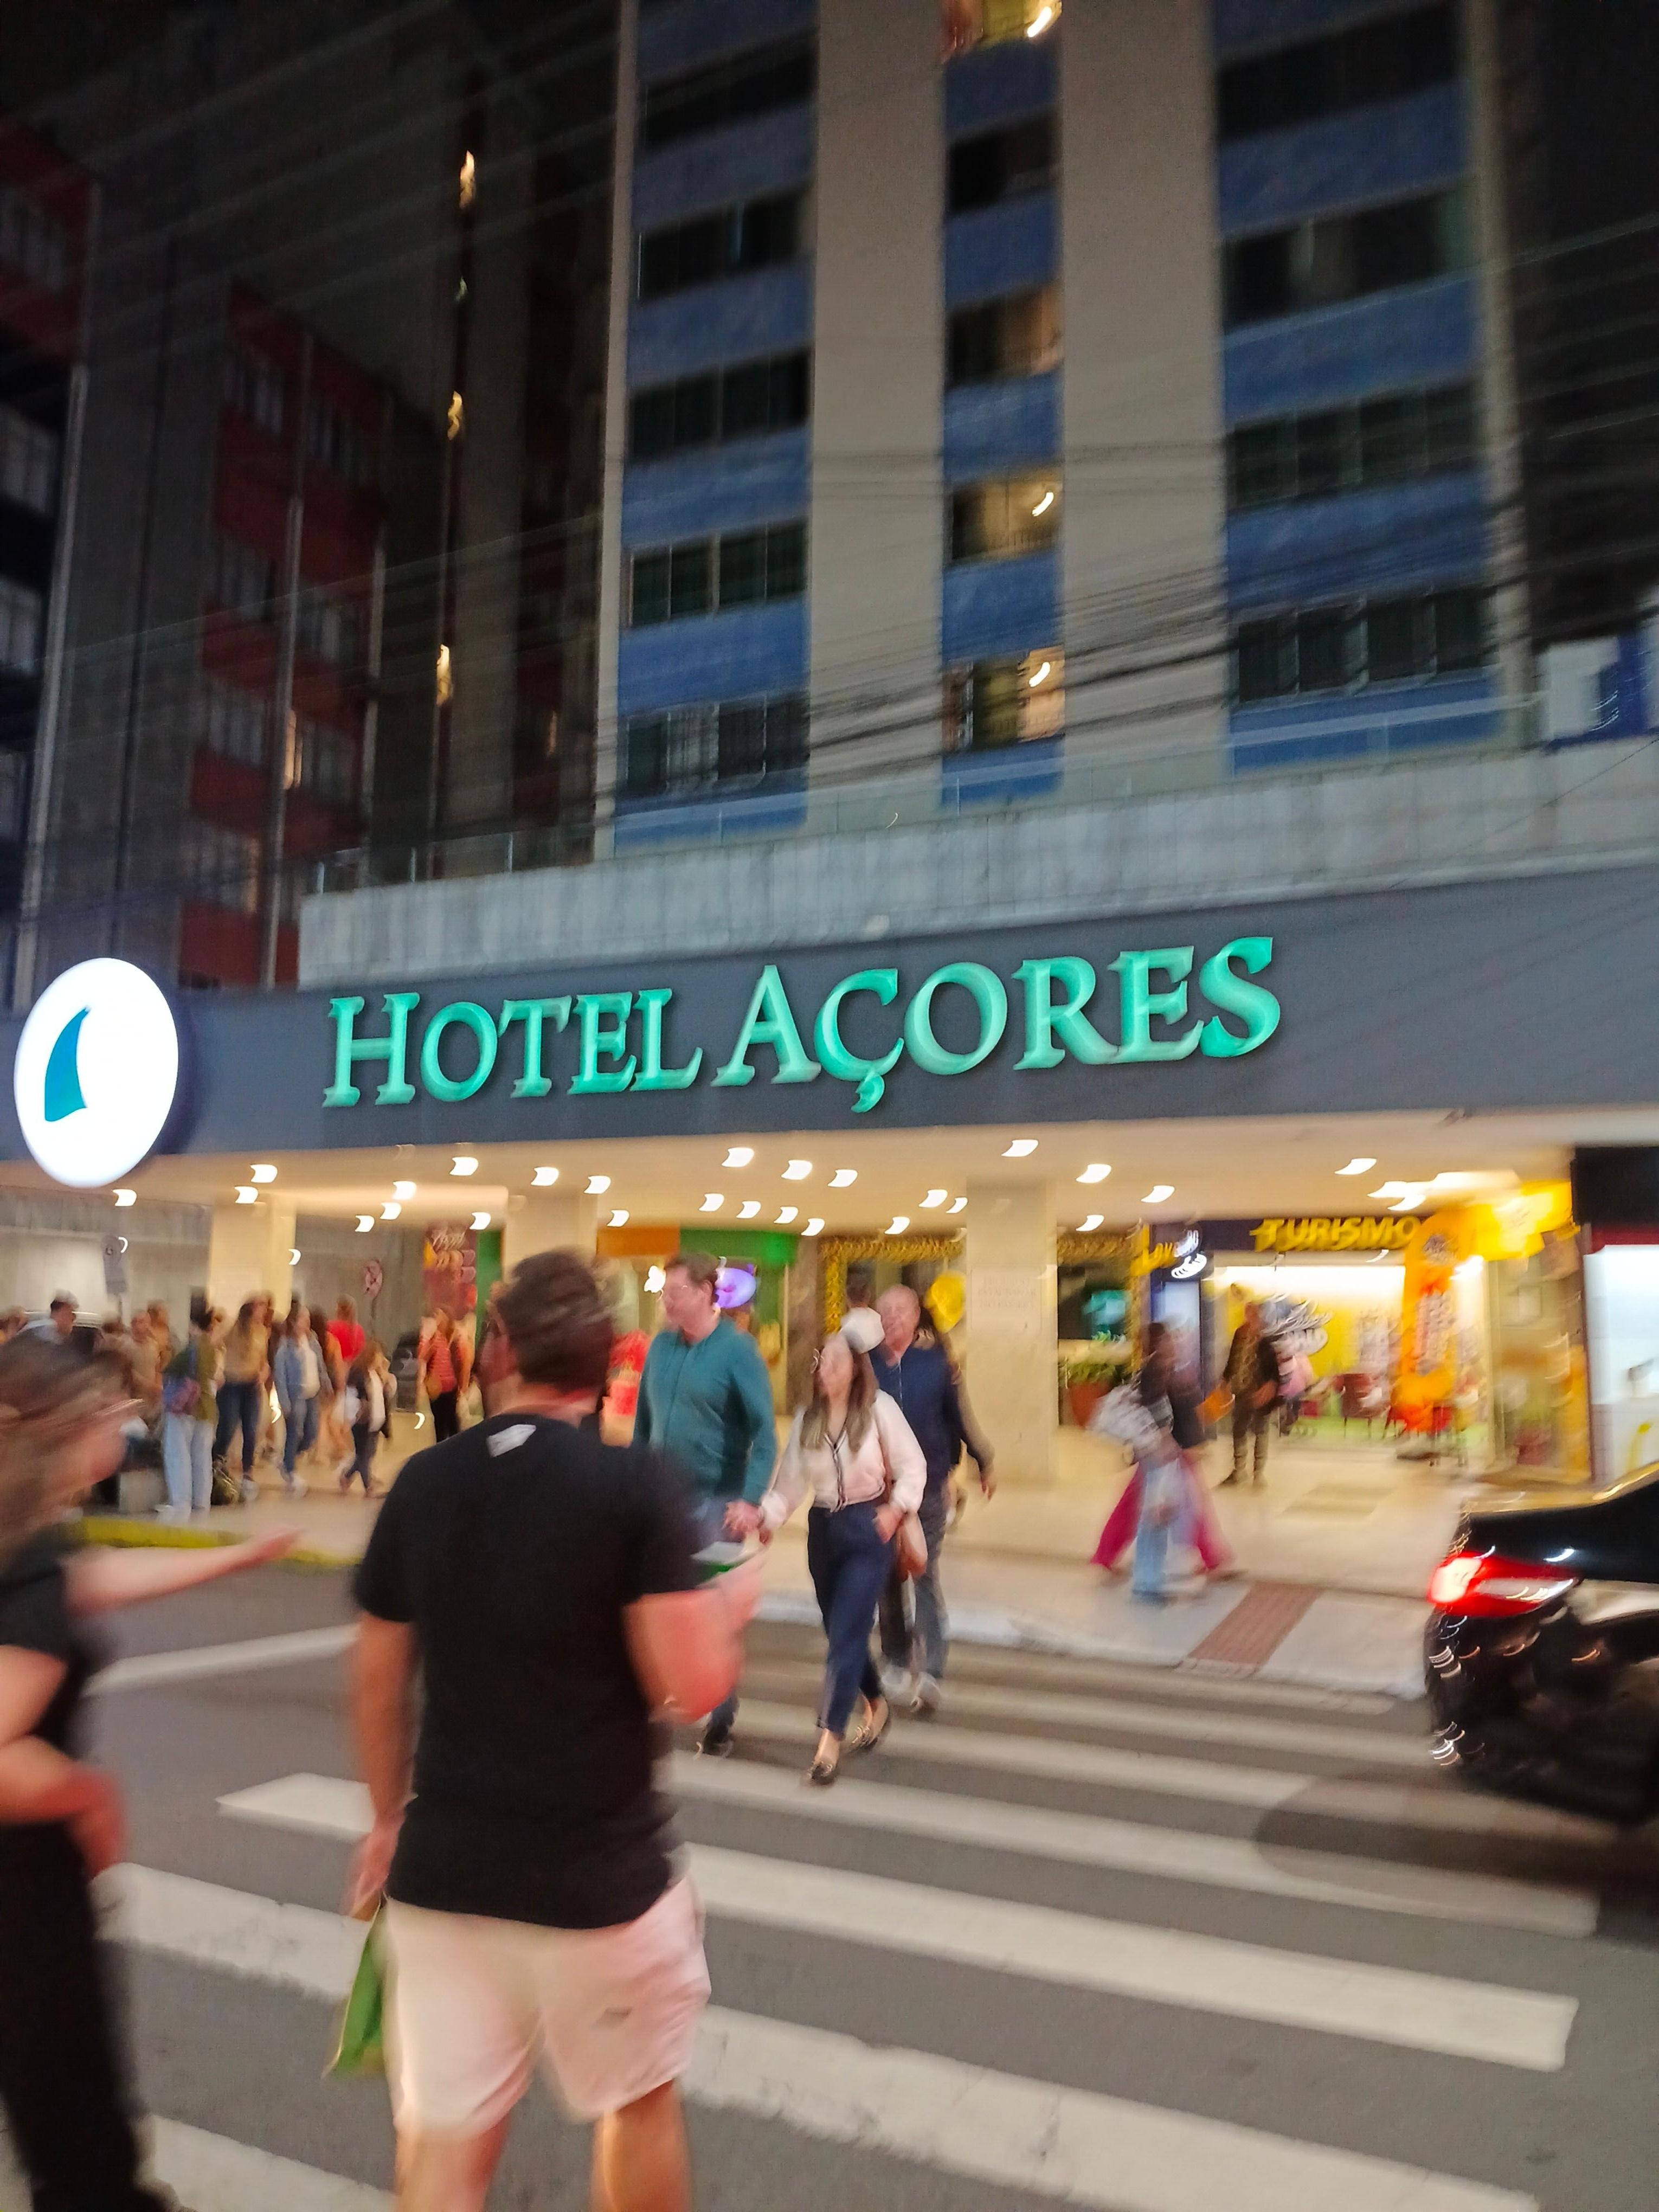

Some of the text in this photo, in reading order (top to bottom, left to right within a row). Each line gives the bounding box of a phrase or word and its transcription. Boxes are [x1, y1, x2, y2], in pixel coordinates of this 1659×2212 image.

[323, 936, 1282, 1114] HOTEL AÇORES
[1250, 1215, 1420, 1251] TURISMO
